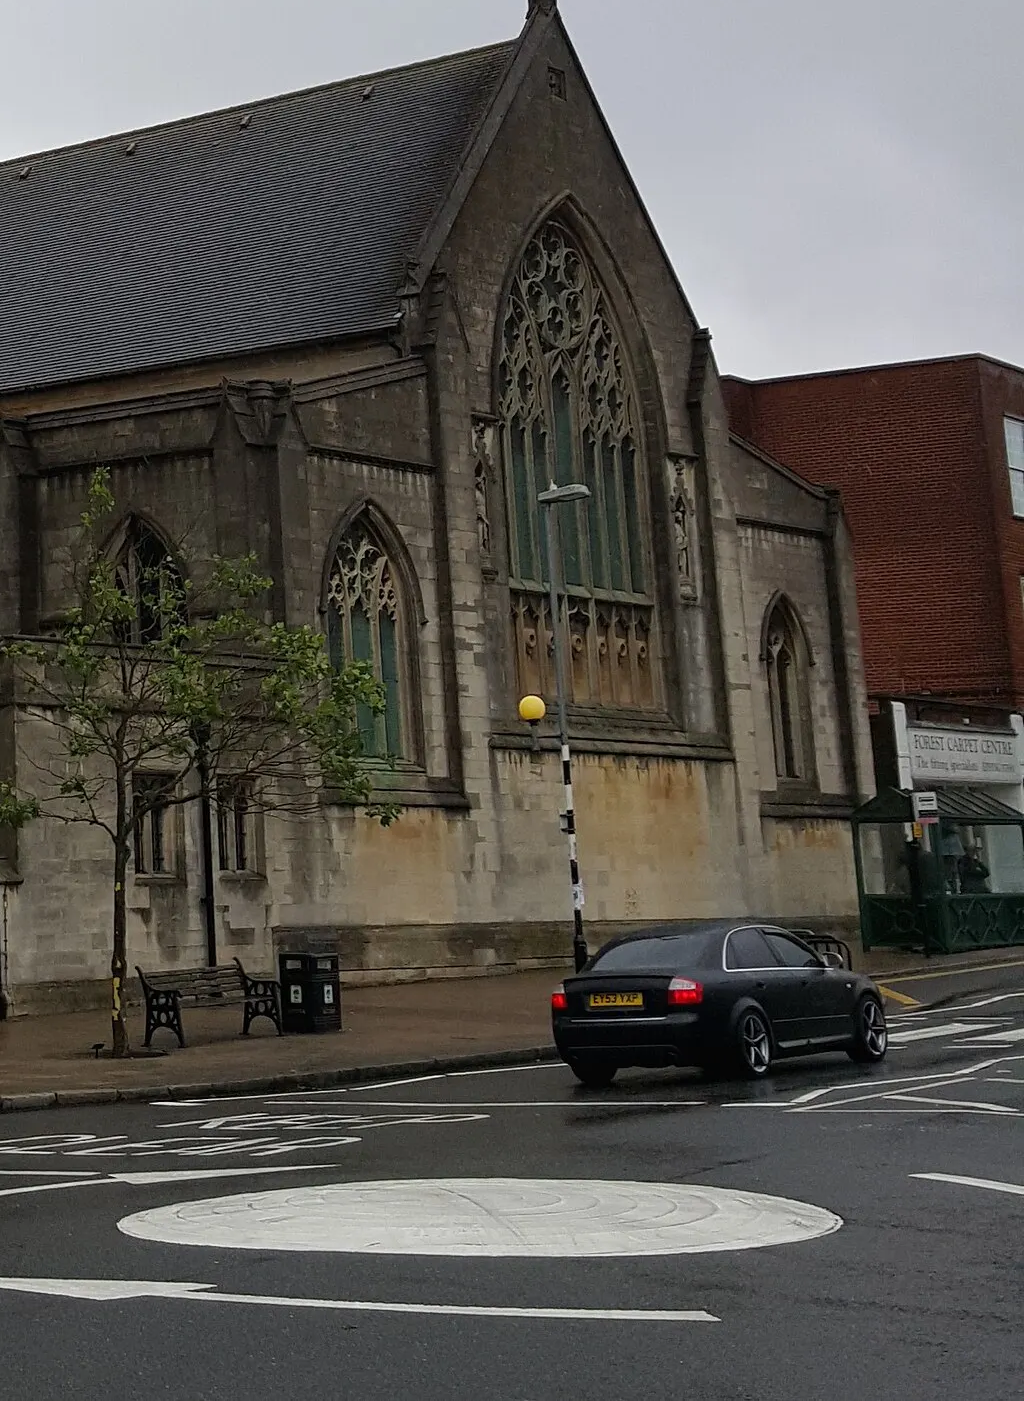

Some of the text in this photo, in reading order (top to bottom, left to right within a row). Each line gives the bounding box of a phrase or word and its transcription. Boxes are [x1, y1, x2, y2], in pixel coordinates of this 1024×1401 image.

[914, 734, 1013, 755] FOREST CARPET CENTRE
[915, 755, 929, 768] The
[593, 994, 617, 1004] EY53
[156, 1113, 491, 1130] KEEP
